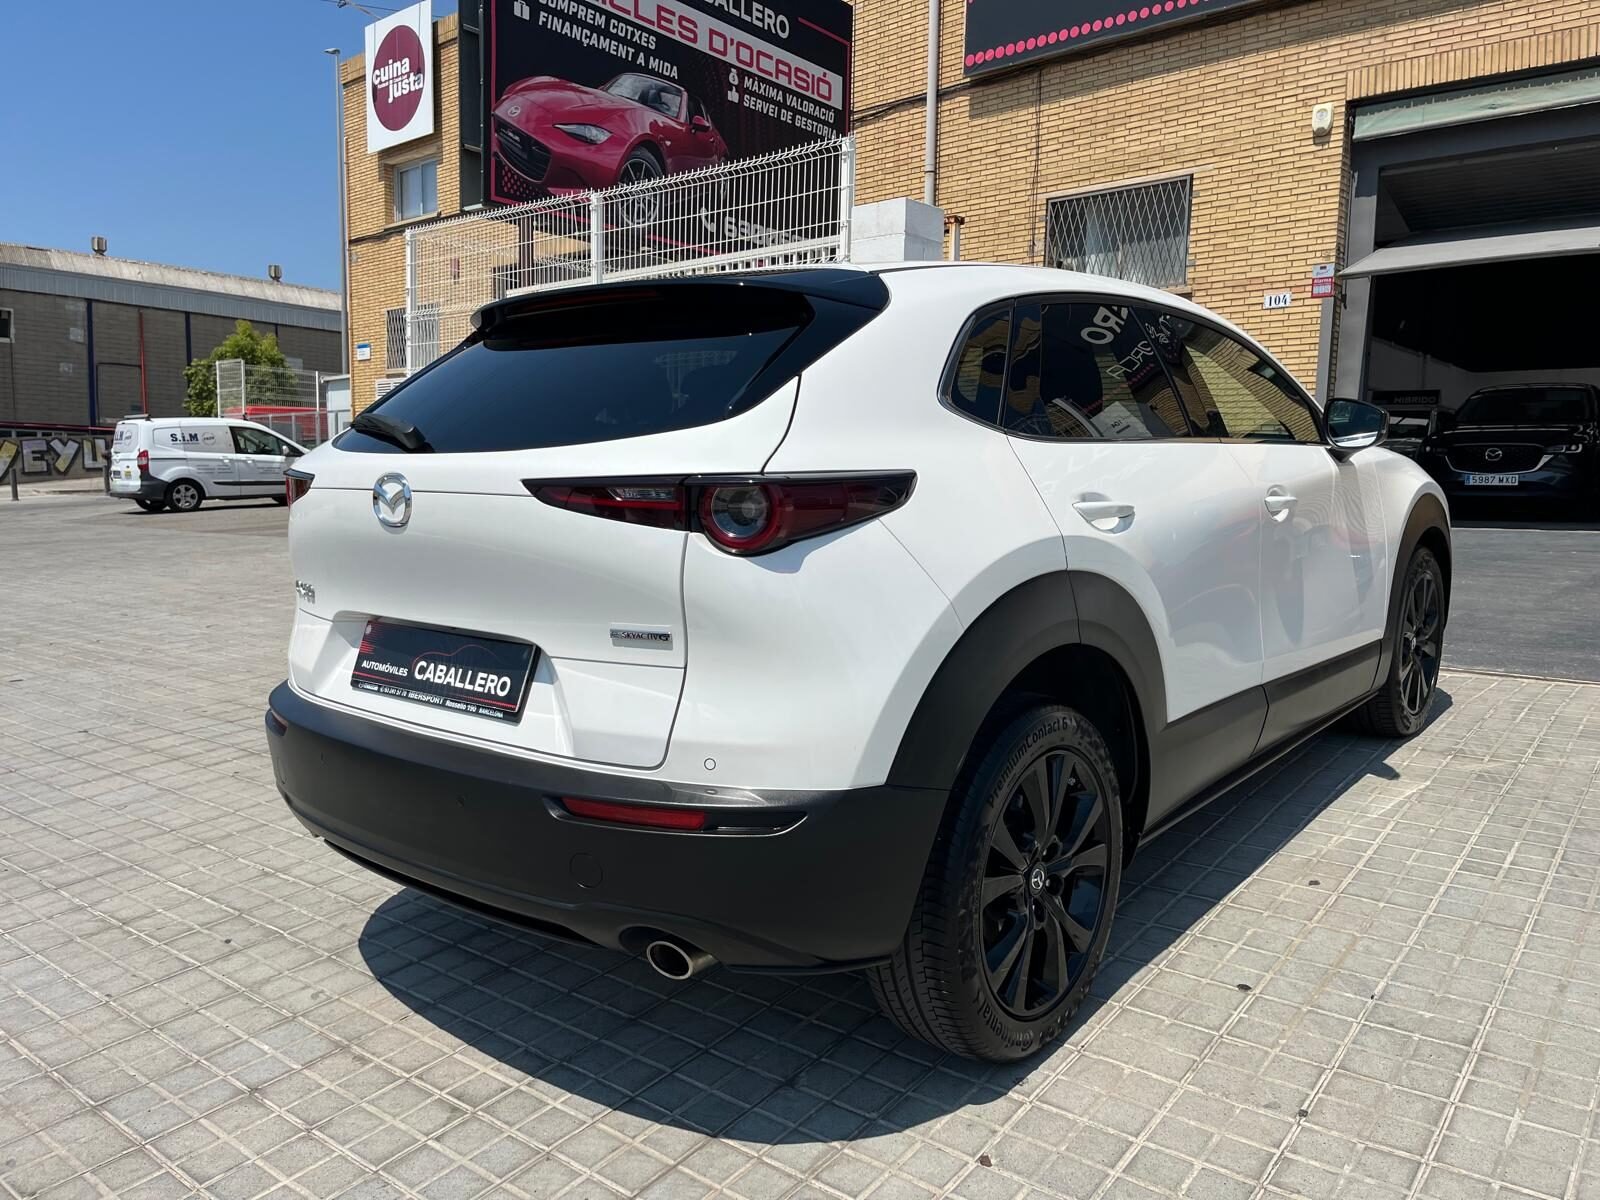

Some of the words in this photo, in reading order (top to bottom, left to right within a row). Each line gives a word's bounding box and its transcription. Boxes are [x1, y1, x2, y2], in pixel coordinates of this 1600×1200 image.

[609, 18, 657, 50] COTXES
[705, 0, 790, 39] LLERO
[538, 11, 635, 61] FINANÇAMENT
[636, 52, 645, 67] A
[649, 55, 679, 80] MIDA
[602, 0, 698, 44] LES
[708, 28, 832, 102] D'OCASIÓ
[373, 57, 410, 85] cuina
[388, 72, 424, 104] justa
[743, 76, 784, 104] MÀXIMA
[786, 95, 835, 124] VALORACIÓ
[743, 95, 778, 119] SERVEI
[780, 109, 793, 124] DE
[1268, 294, 1288, 307] 104
[1472, 475, 1496, 484] 5987
[361, 659, 408, 677] AUTOMÓVILES
[413, 659, 511, 697] CABALLERO
[1062, 716, 1068, 730] 6
